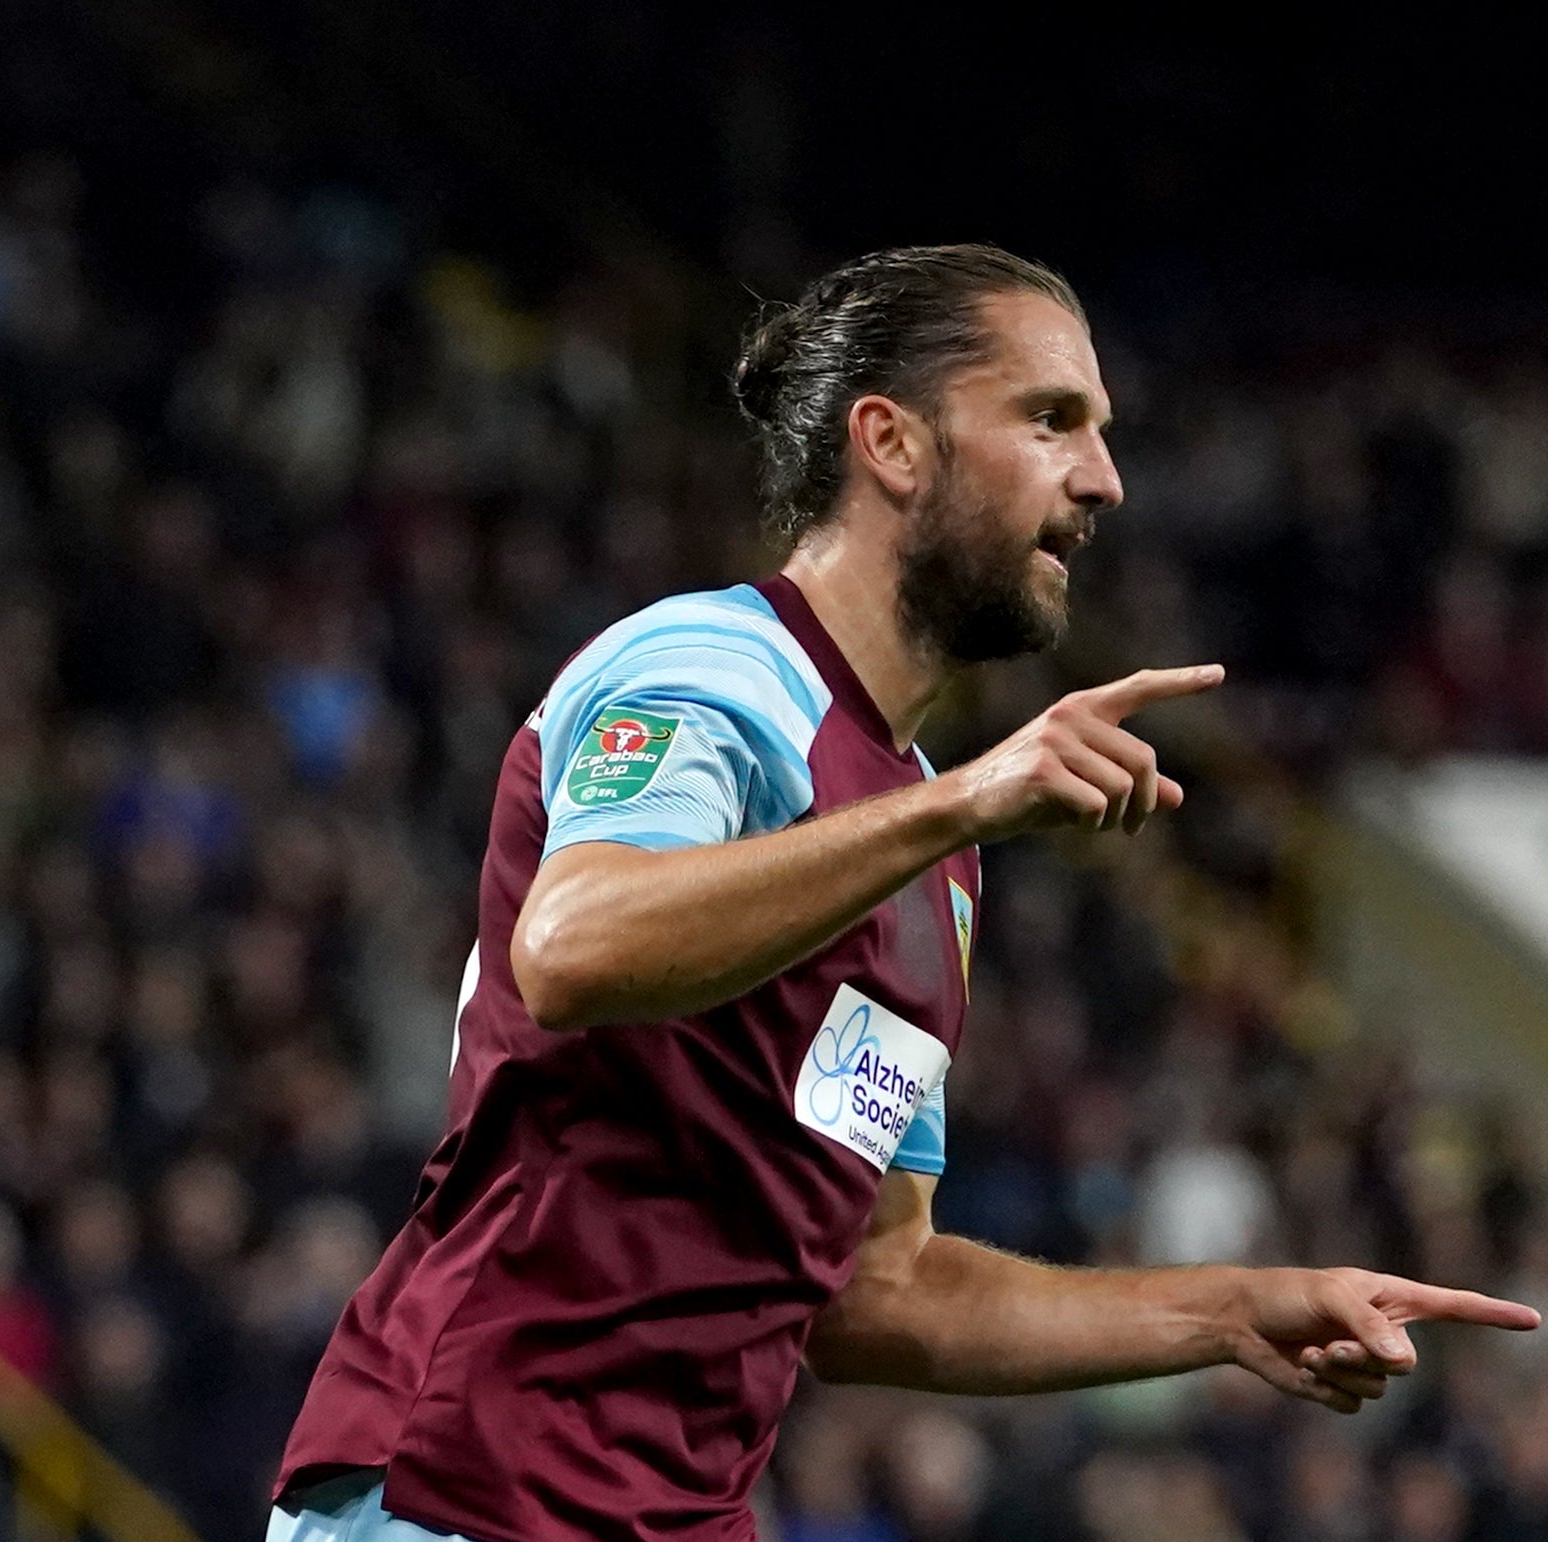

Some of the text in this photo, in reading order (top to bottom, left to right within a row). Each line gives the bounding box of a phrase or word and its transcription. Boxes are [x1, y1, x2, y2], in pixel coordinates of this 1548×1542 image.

[575, 749, 658, 769] Carabao
[590, 764, 629, 779] Cup
[597, 788, 618, 798] EFL
[848, 1124, 878, 1154] United
